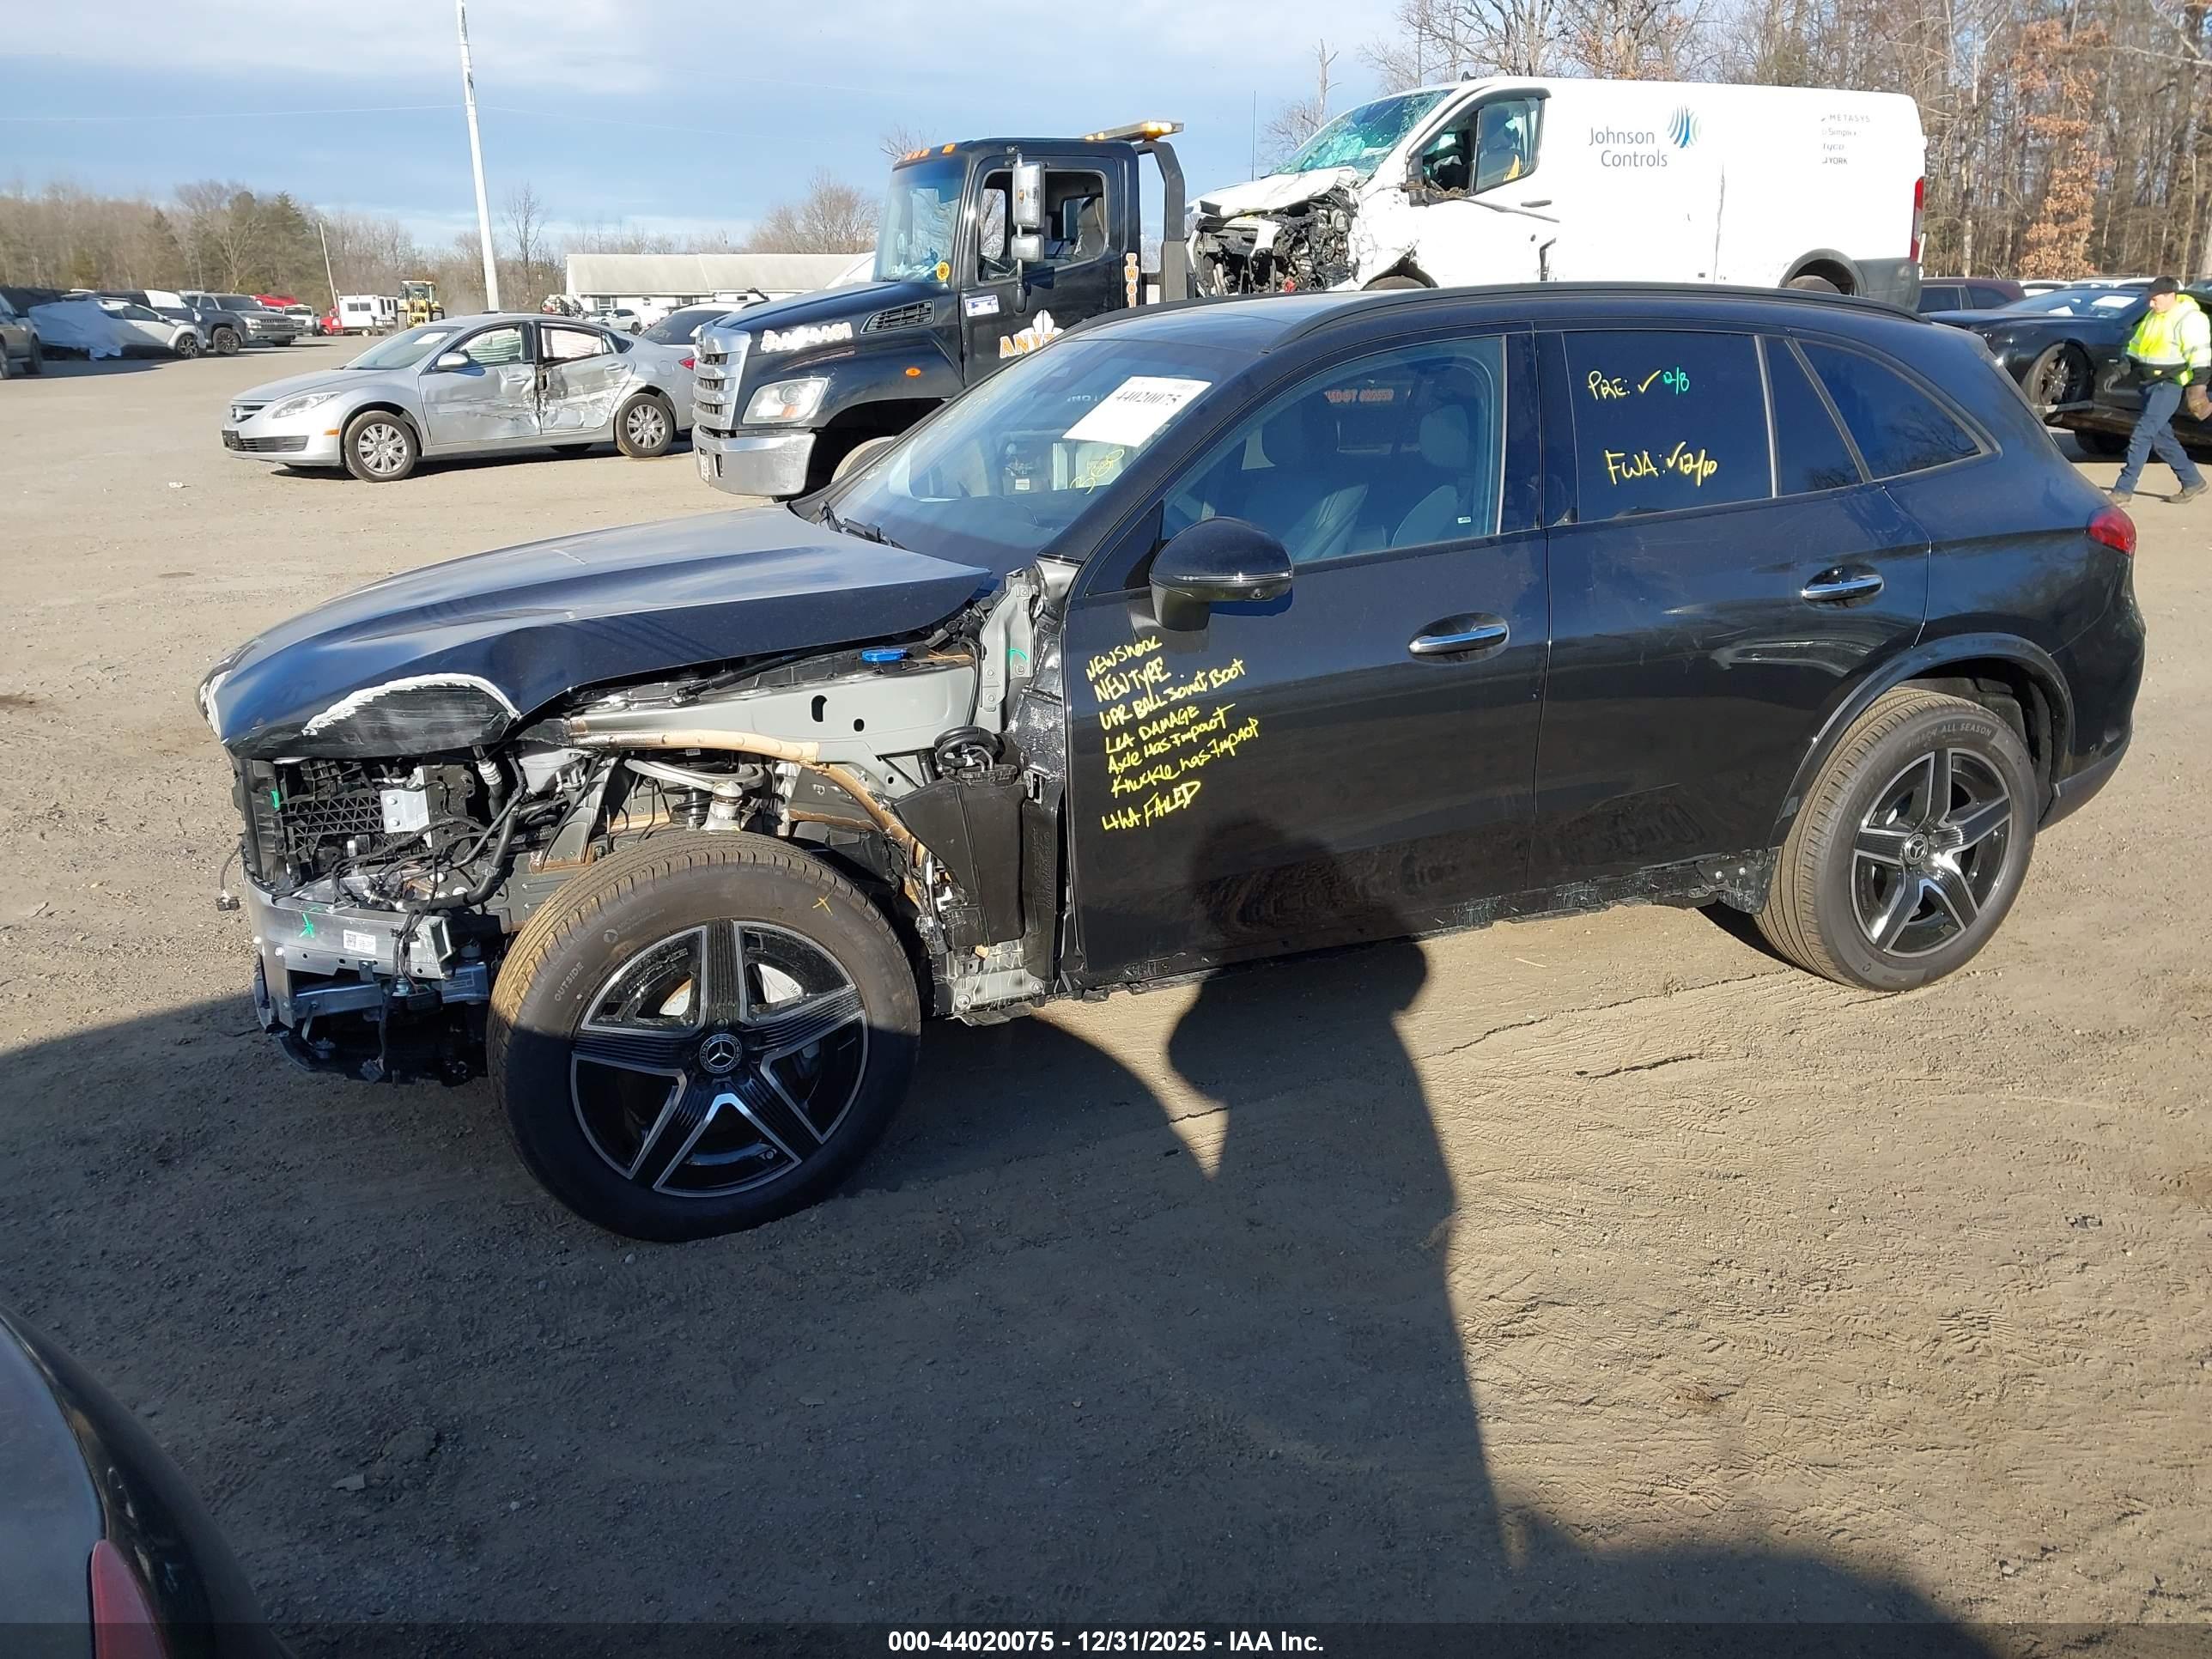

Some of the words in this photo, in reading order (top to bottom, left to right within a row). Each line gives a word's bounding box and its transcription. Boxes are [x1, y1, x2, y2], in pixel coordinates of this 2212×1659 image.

[1589, 125, 1655, 146] Johnson
[1601, 149, 1668, 167] Controls
[1099, 703, 1133, 730] UPR
[1138, 705, 1200, 741] DAMAGE
[1960, 722, 1992, 737] SEASON
[1142, 781, 1201, 828] FAILED
[554, 961, 584, 1002] OUTSIDE
